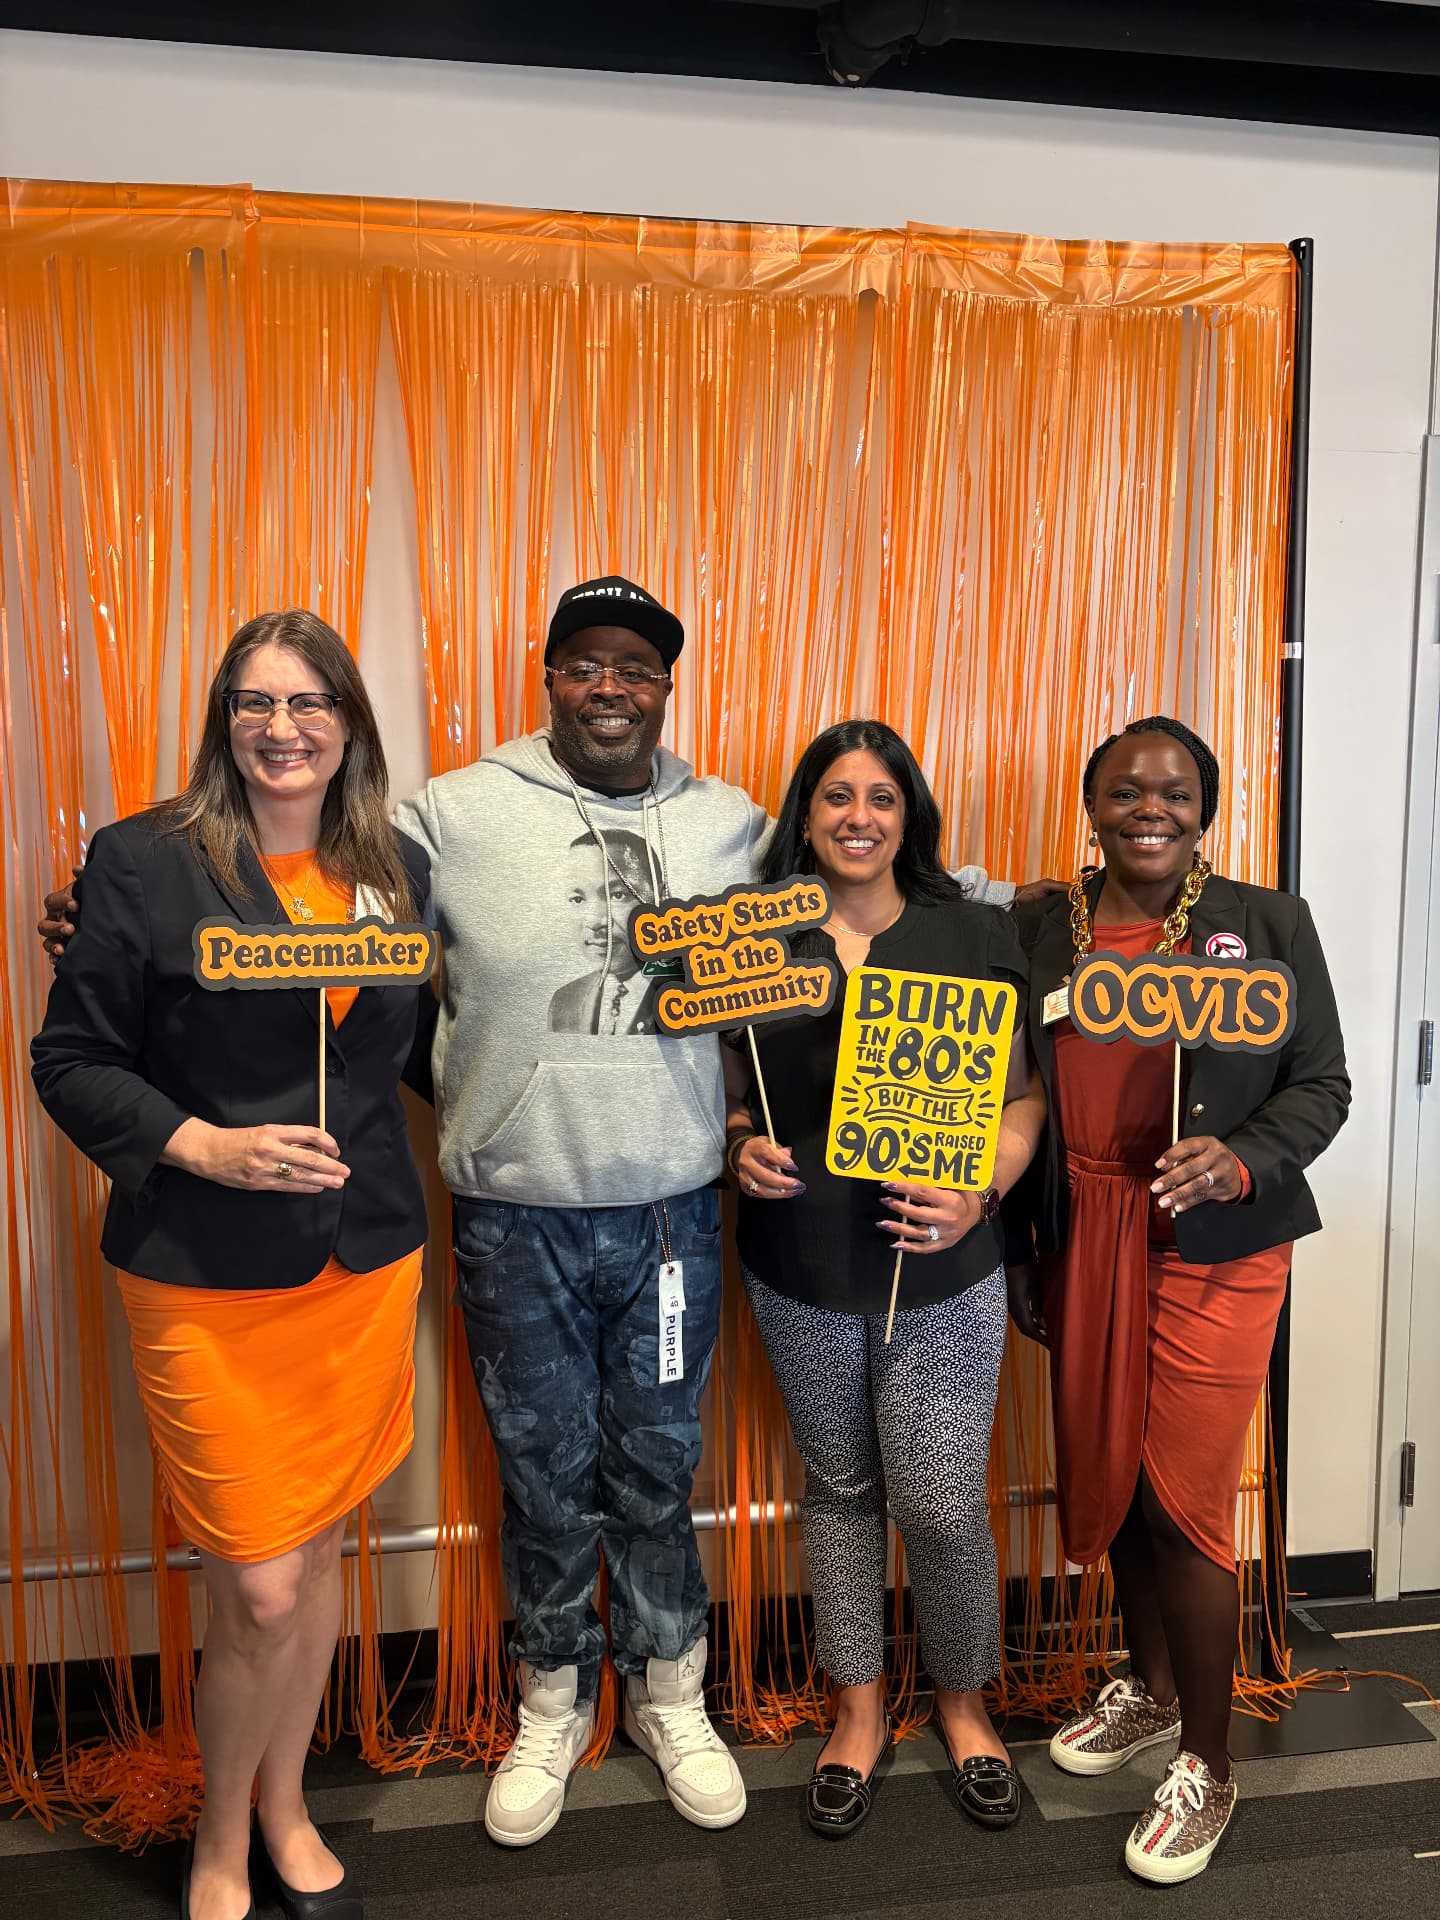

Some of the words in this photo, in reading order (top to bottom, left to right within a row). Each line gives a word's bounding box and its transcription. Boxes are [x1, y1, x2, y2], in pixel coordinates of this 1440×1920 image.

[641, 912, 725, 946] Safety
[733, 891, 821, 926] Starts
[207, 935, 423, 970] Peacemaker
[695, 953, 726, 978] in
[732, 944, 778, 970] the
[664, 974, 825, 1021] Community
[854, 973, 1008, 1036] BORN
[1081, 969, 1282, 1035] OCVIS
[856, 1046, 887, 1064] THE
[888, 1027, 996, 1085] 80'S
[858, 1024, 891, 1046] IN
[879, 1089, 918, 1110] BUT
[922, 1099, 958, 1121] THE
[834, 1121, 933, 1173] 90'S
[934, 1131, 986, 1151] RAISED
[933, 1149, 982, 1185] ME
[665, 1315, 677, 1377] PURPLE
